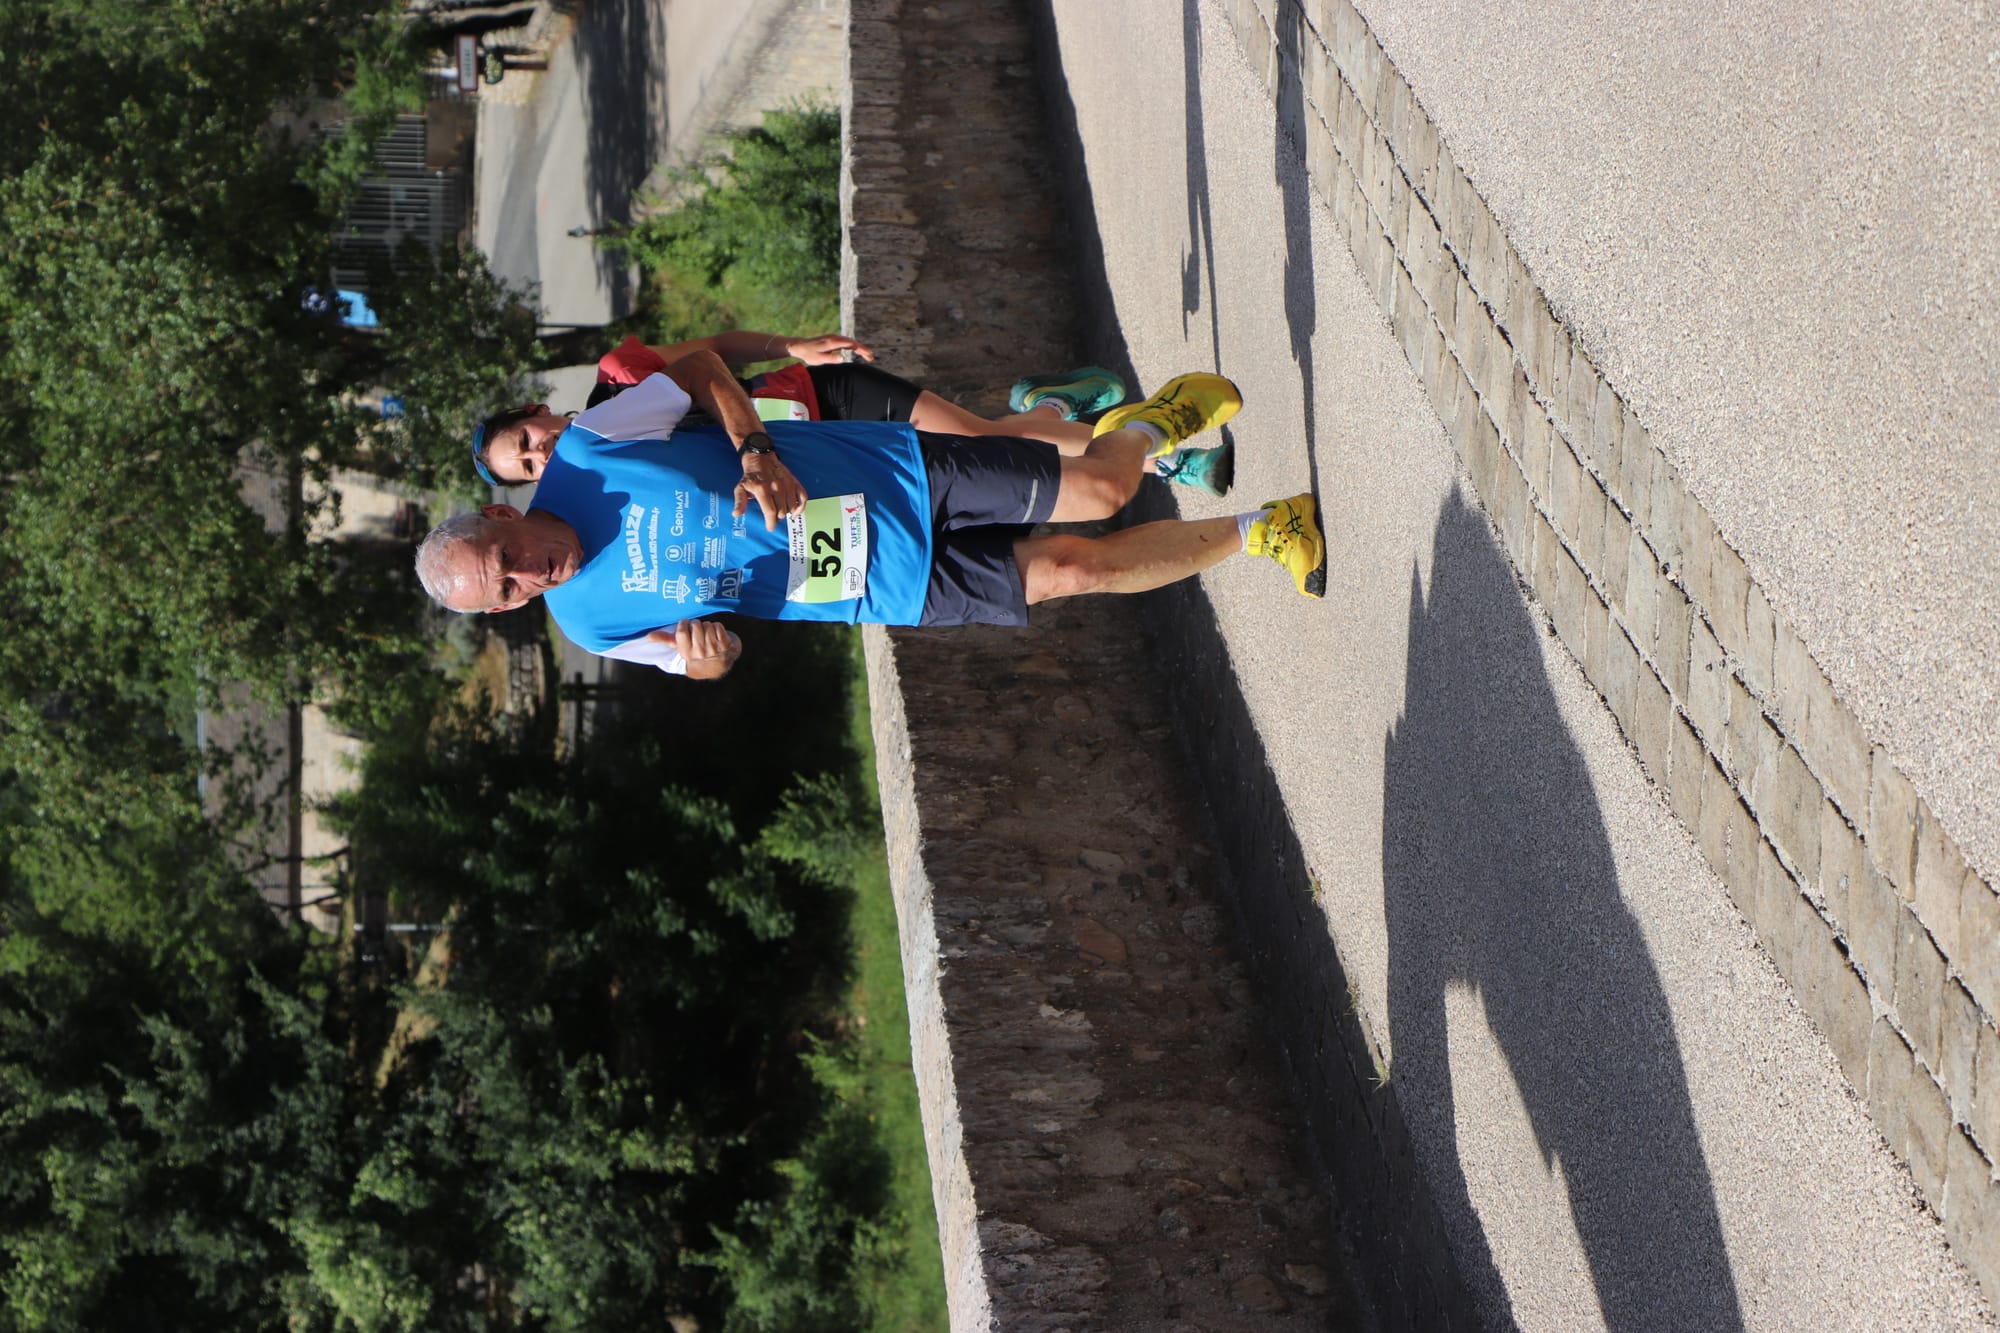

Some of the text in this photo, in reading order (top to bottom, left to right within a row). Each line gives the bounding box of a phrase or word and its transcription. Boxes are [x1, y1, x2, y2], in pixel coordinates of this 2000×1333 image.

[849, 516, 858, 548] TUFF'S
[669, 548, 679, 558] U
[811, 528, 842, 578] 52
